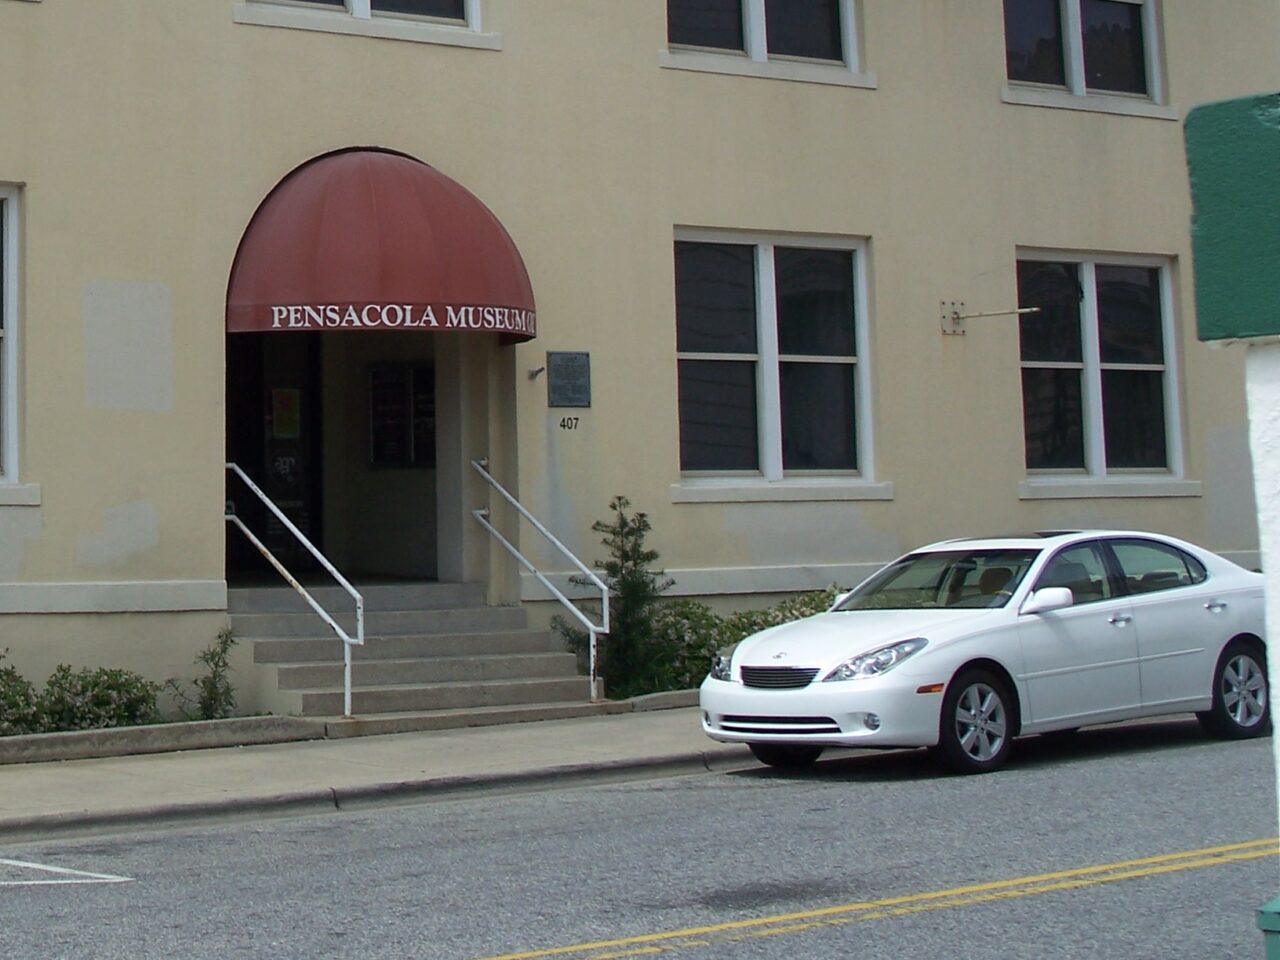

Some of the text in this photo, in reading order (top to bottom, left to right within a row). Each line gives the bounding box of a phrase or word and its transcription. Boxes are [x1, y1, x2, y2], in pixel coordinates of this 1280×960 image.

[271, 304, 438, 328] PENSACOLA
[445, 305, 526, 331] MUSEUM
[560, 417, 580, 430] 407
